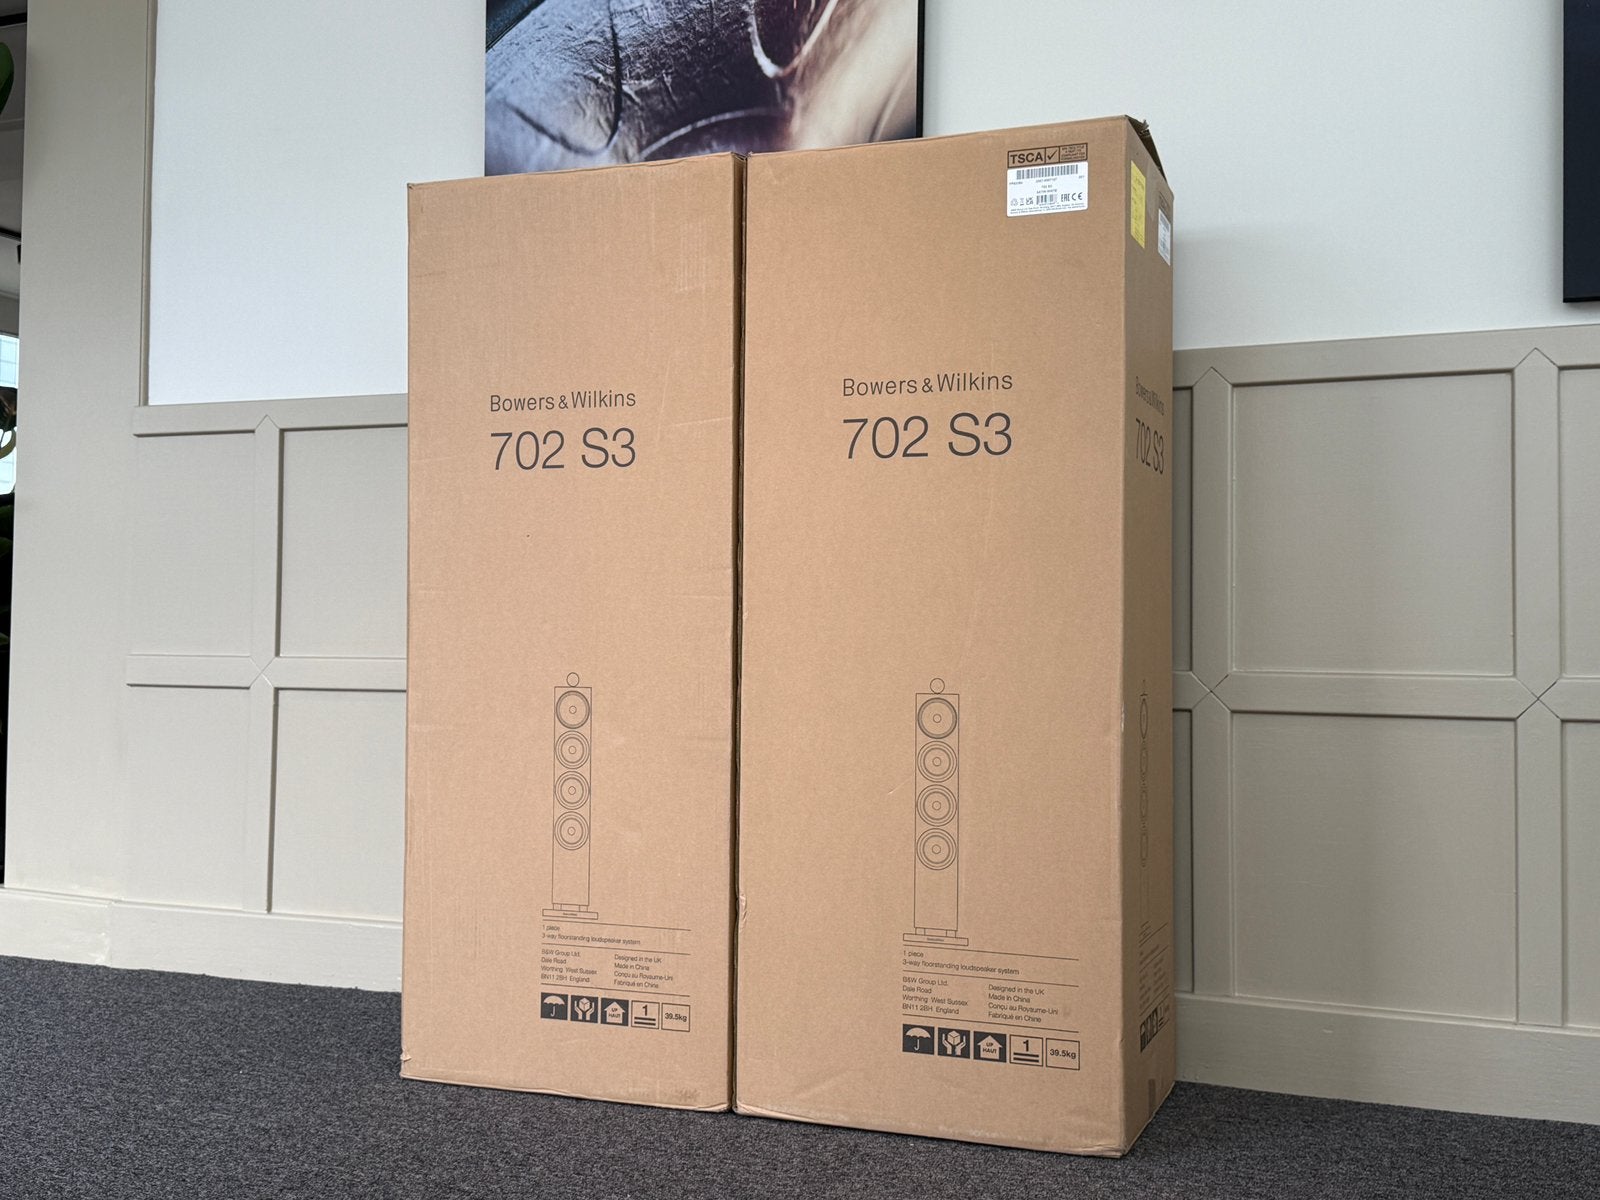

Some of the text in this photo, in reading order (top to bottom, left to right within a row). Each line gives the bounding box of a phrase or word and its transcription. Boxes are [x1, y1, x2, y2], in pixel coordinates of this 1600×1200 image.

[1010, 151, 1043, 164] TSCA
[840, 372, 1013, 397] Bowers & Wilkins
[490, 389, 636, 413] Bowers & Wilkins
[843, 412, 1013, 460] 702 S3
[490, 427, 636, 471] 702 S3
[1136, 417, 1165, 475] 702 S3
[558, 933, 590, 942] floorstanding
[555, 949, 570, 957] Group
[614, 954, 638, 962] Designed
[902, 959, 1020, 976] 3-way floorstanding loudspeaker system
[918, 978, 937, 986] Group
[916, 986, 932, 994] Road
[988, 984, 1016, 993] Designed
[946, 998, 969, 1006] Sussex
[988, 993, 1006, 1001] Made
[1012, 995, 1031, 1003] China
[642, 1004, 648, 1016] 1
[935, 1006, 960, 1015] England
[1017, 1005, 1059, 1015] Royaume-Uni
[664, 1012, 688, 1023] 39.5kg
[1023, 1014, 1042, 1023] Chine
[1022, 1040, 1030, 1052] 1
[1049, 1049, 1077, 1060] 39.5kg
